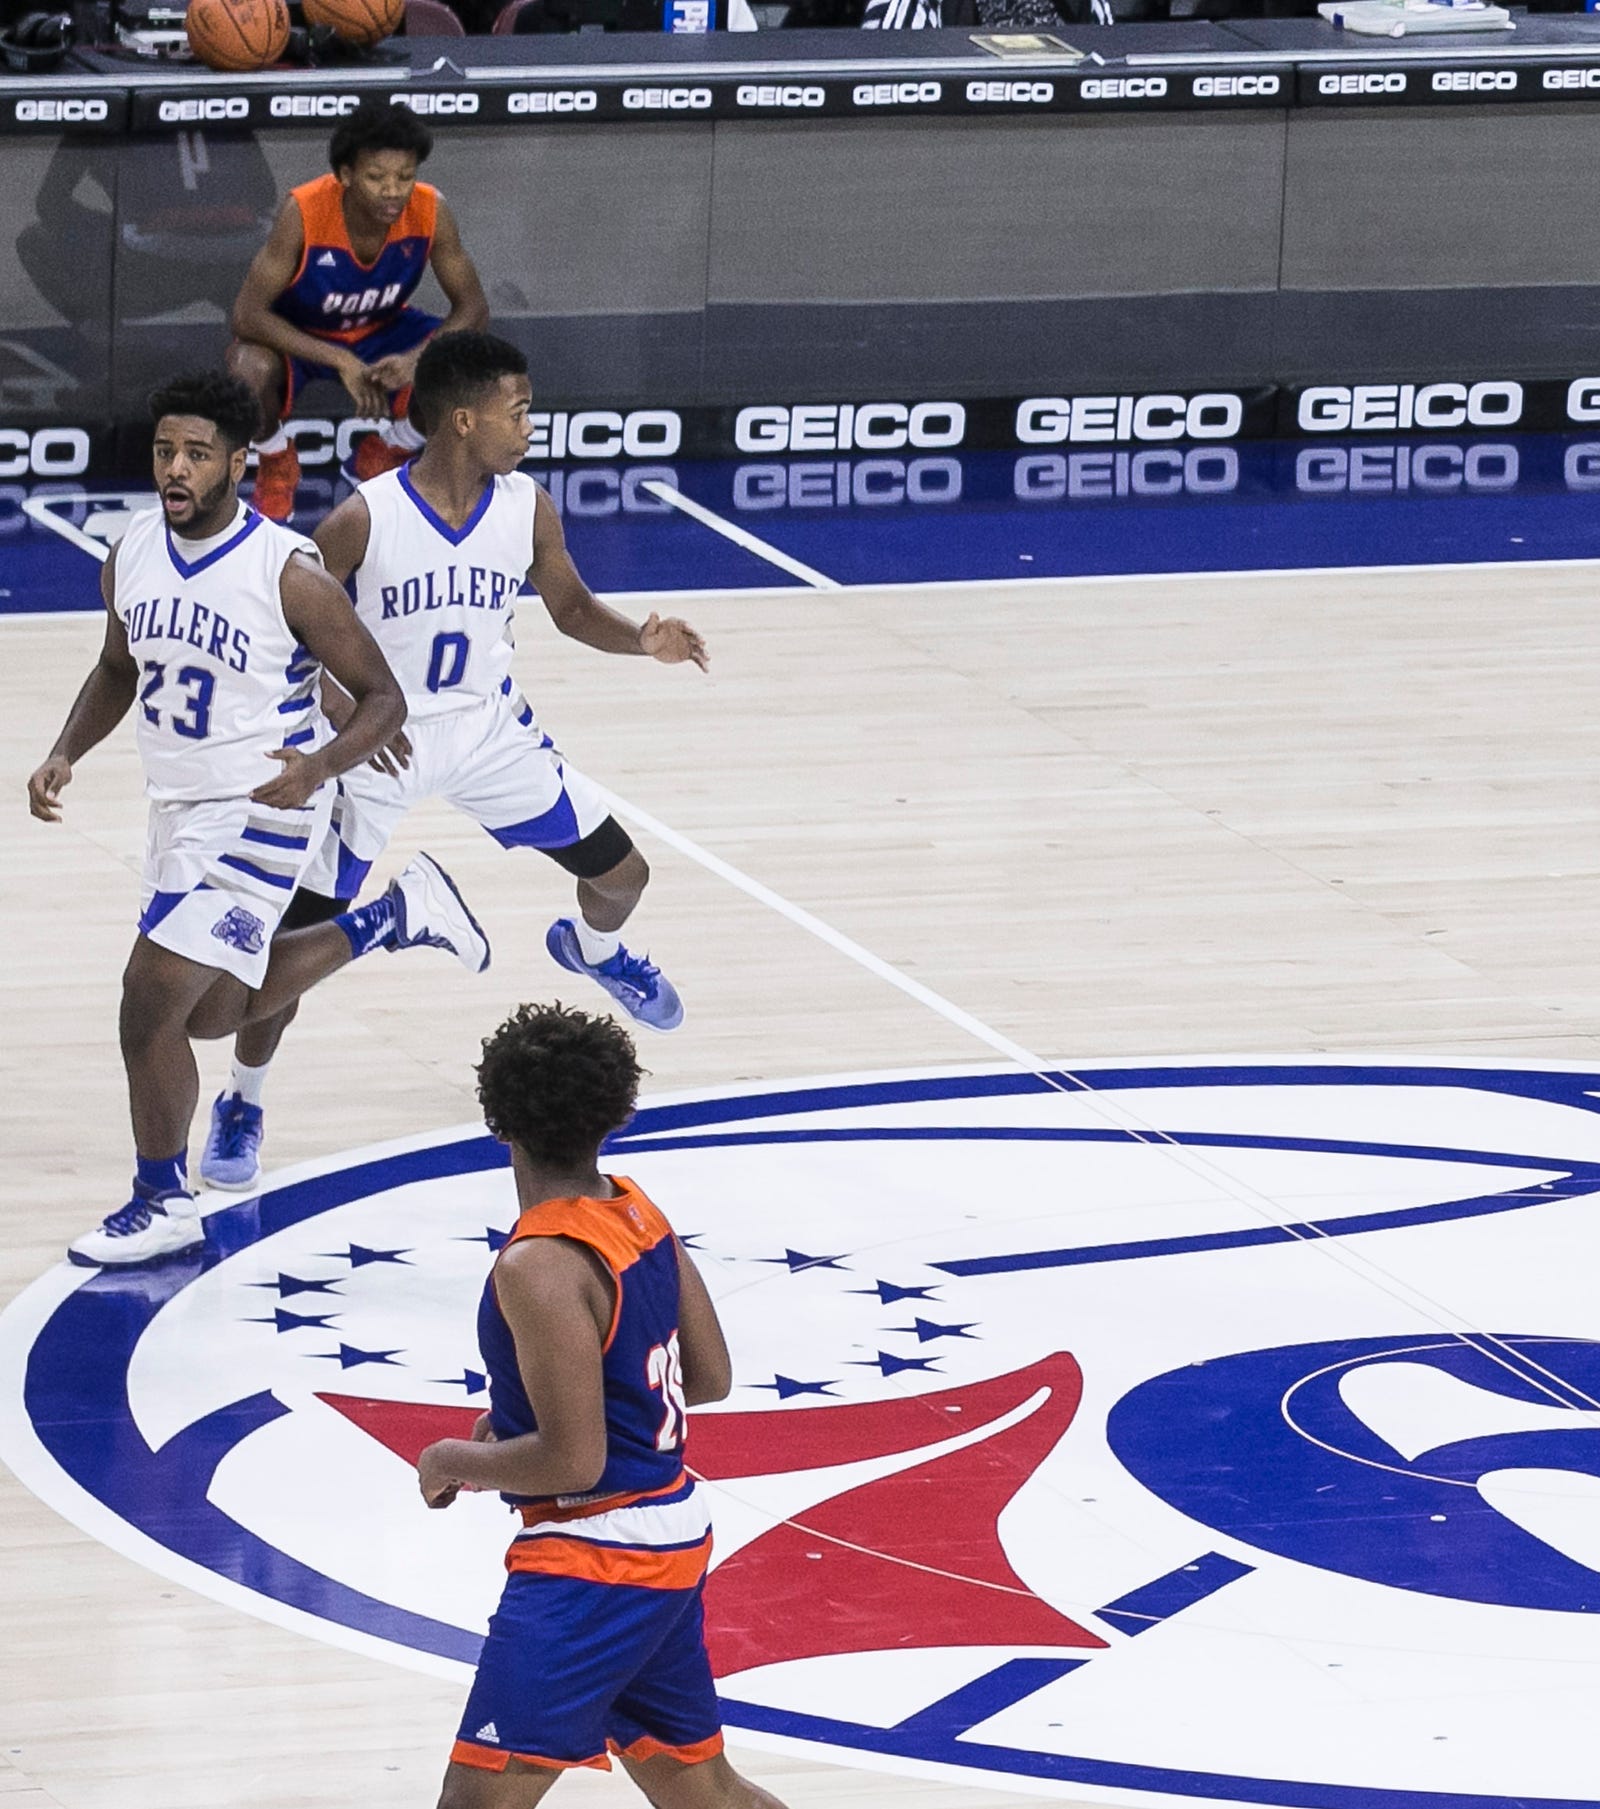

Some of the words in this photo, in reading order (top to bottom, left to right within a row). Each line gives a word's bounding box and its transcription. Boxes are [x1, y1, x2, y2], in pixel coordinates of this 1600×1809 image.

[158, 98, 250, 121] GEICO
[507, 90, 598, 113] GEICO
[622, 87, 713, 110] GEICO
[736, 85, 826, 108] GEICO
[852, 82, 942, 105] GEICO
[965, 80, 1055, 104] GEICO
[1080, 78, 1168, 101] GEICO
[1192, 75, 1280, 98] GEICO
[1318, 72, 1407, 95] GEICO
[1431, 70, 1518, 92] GEICO
[15, 99, 109, 122] GEICO
[525, 409, 682, 459] EICO
[734, 402, 966, 452] GEICO
[1015, 393, 1243, 443] GEICO
[1298, 381, 1524, 430] GEICO
[426, 630, 471, 694] 0
[140, 658, 217, 740] 23
